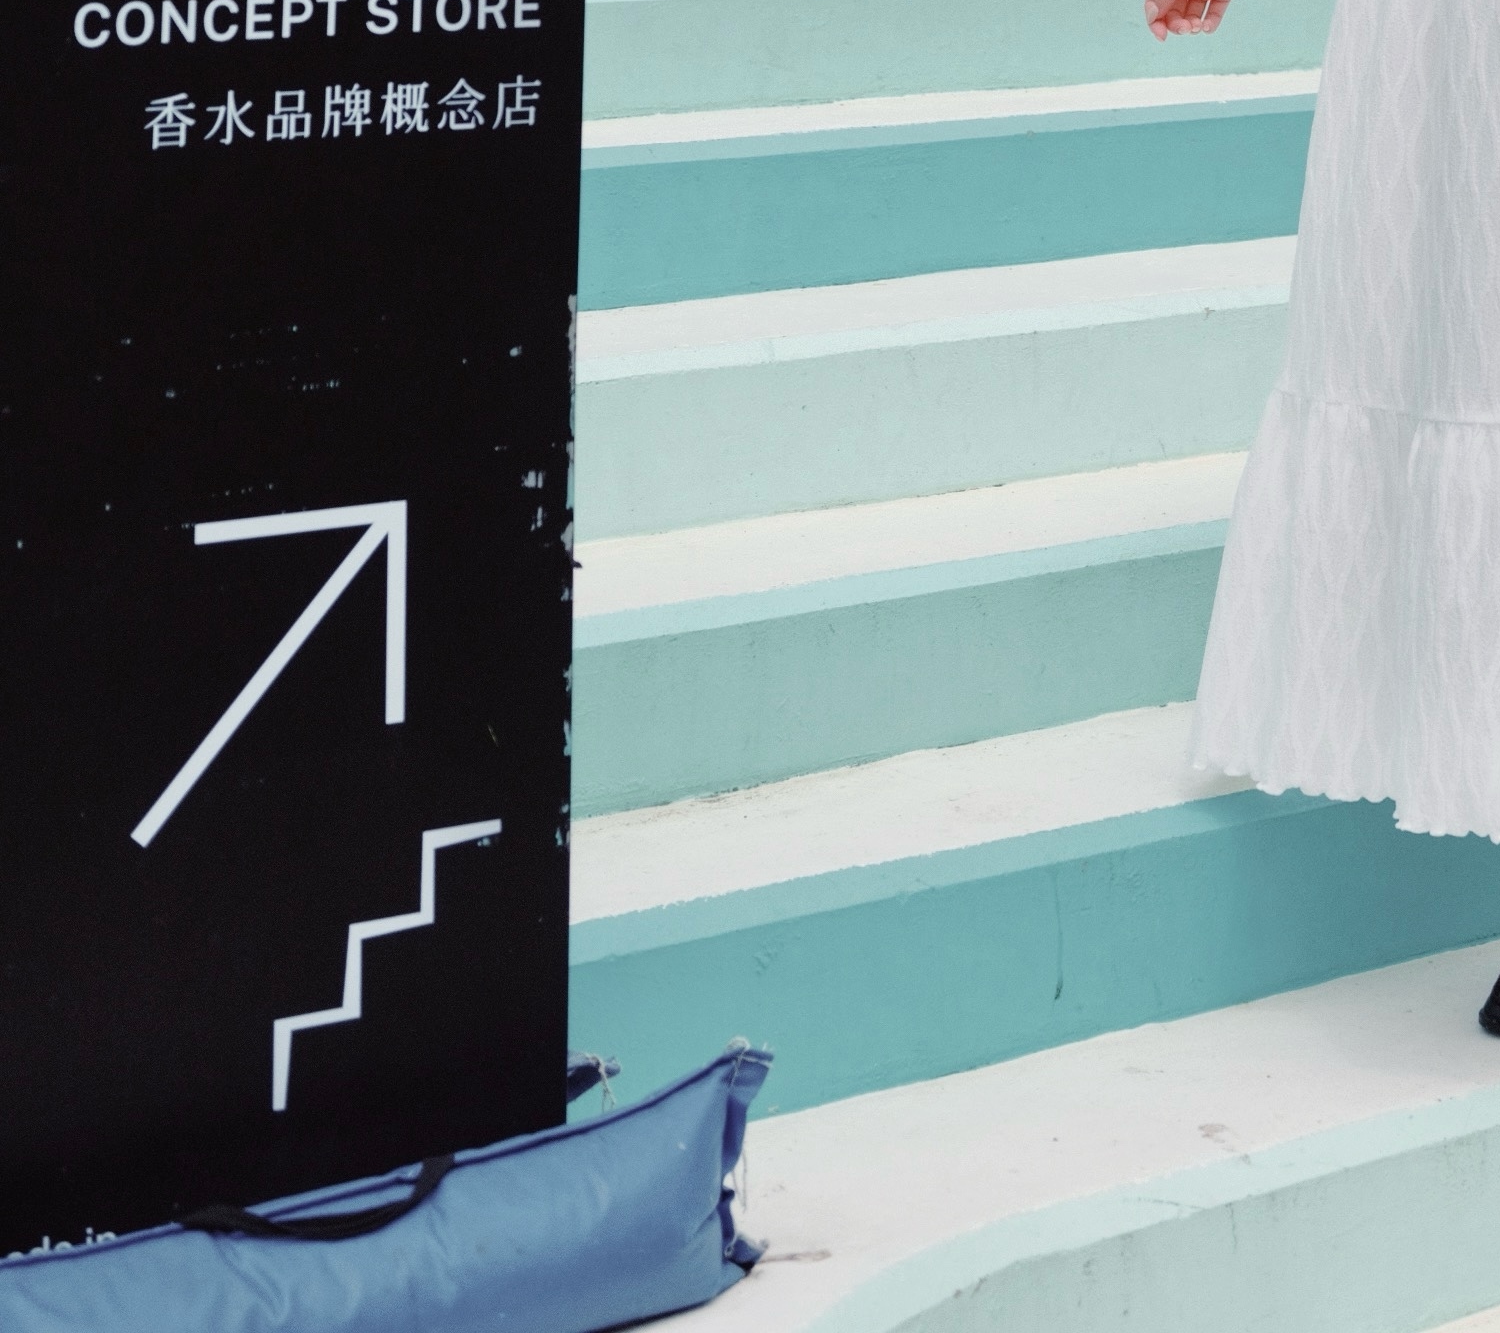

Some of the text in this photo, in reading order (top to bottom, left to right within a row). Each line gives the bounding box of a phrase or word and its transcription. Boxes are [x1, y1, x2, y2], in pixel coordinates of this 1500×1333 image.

[144, 74, 542, 151] 香水品牌概念店
